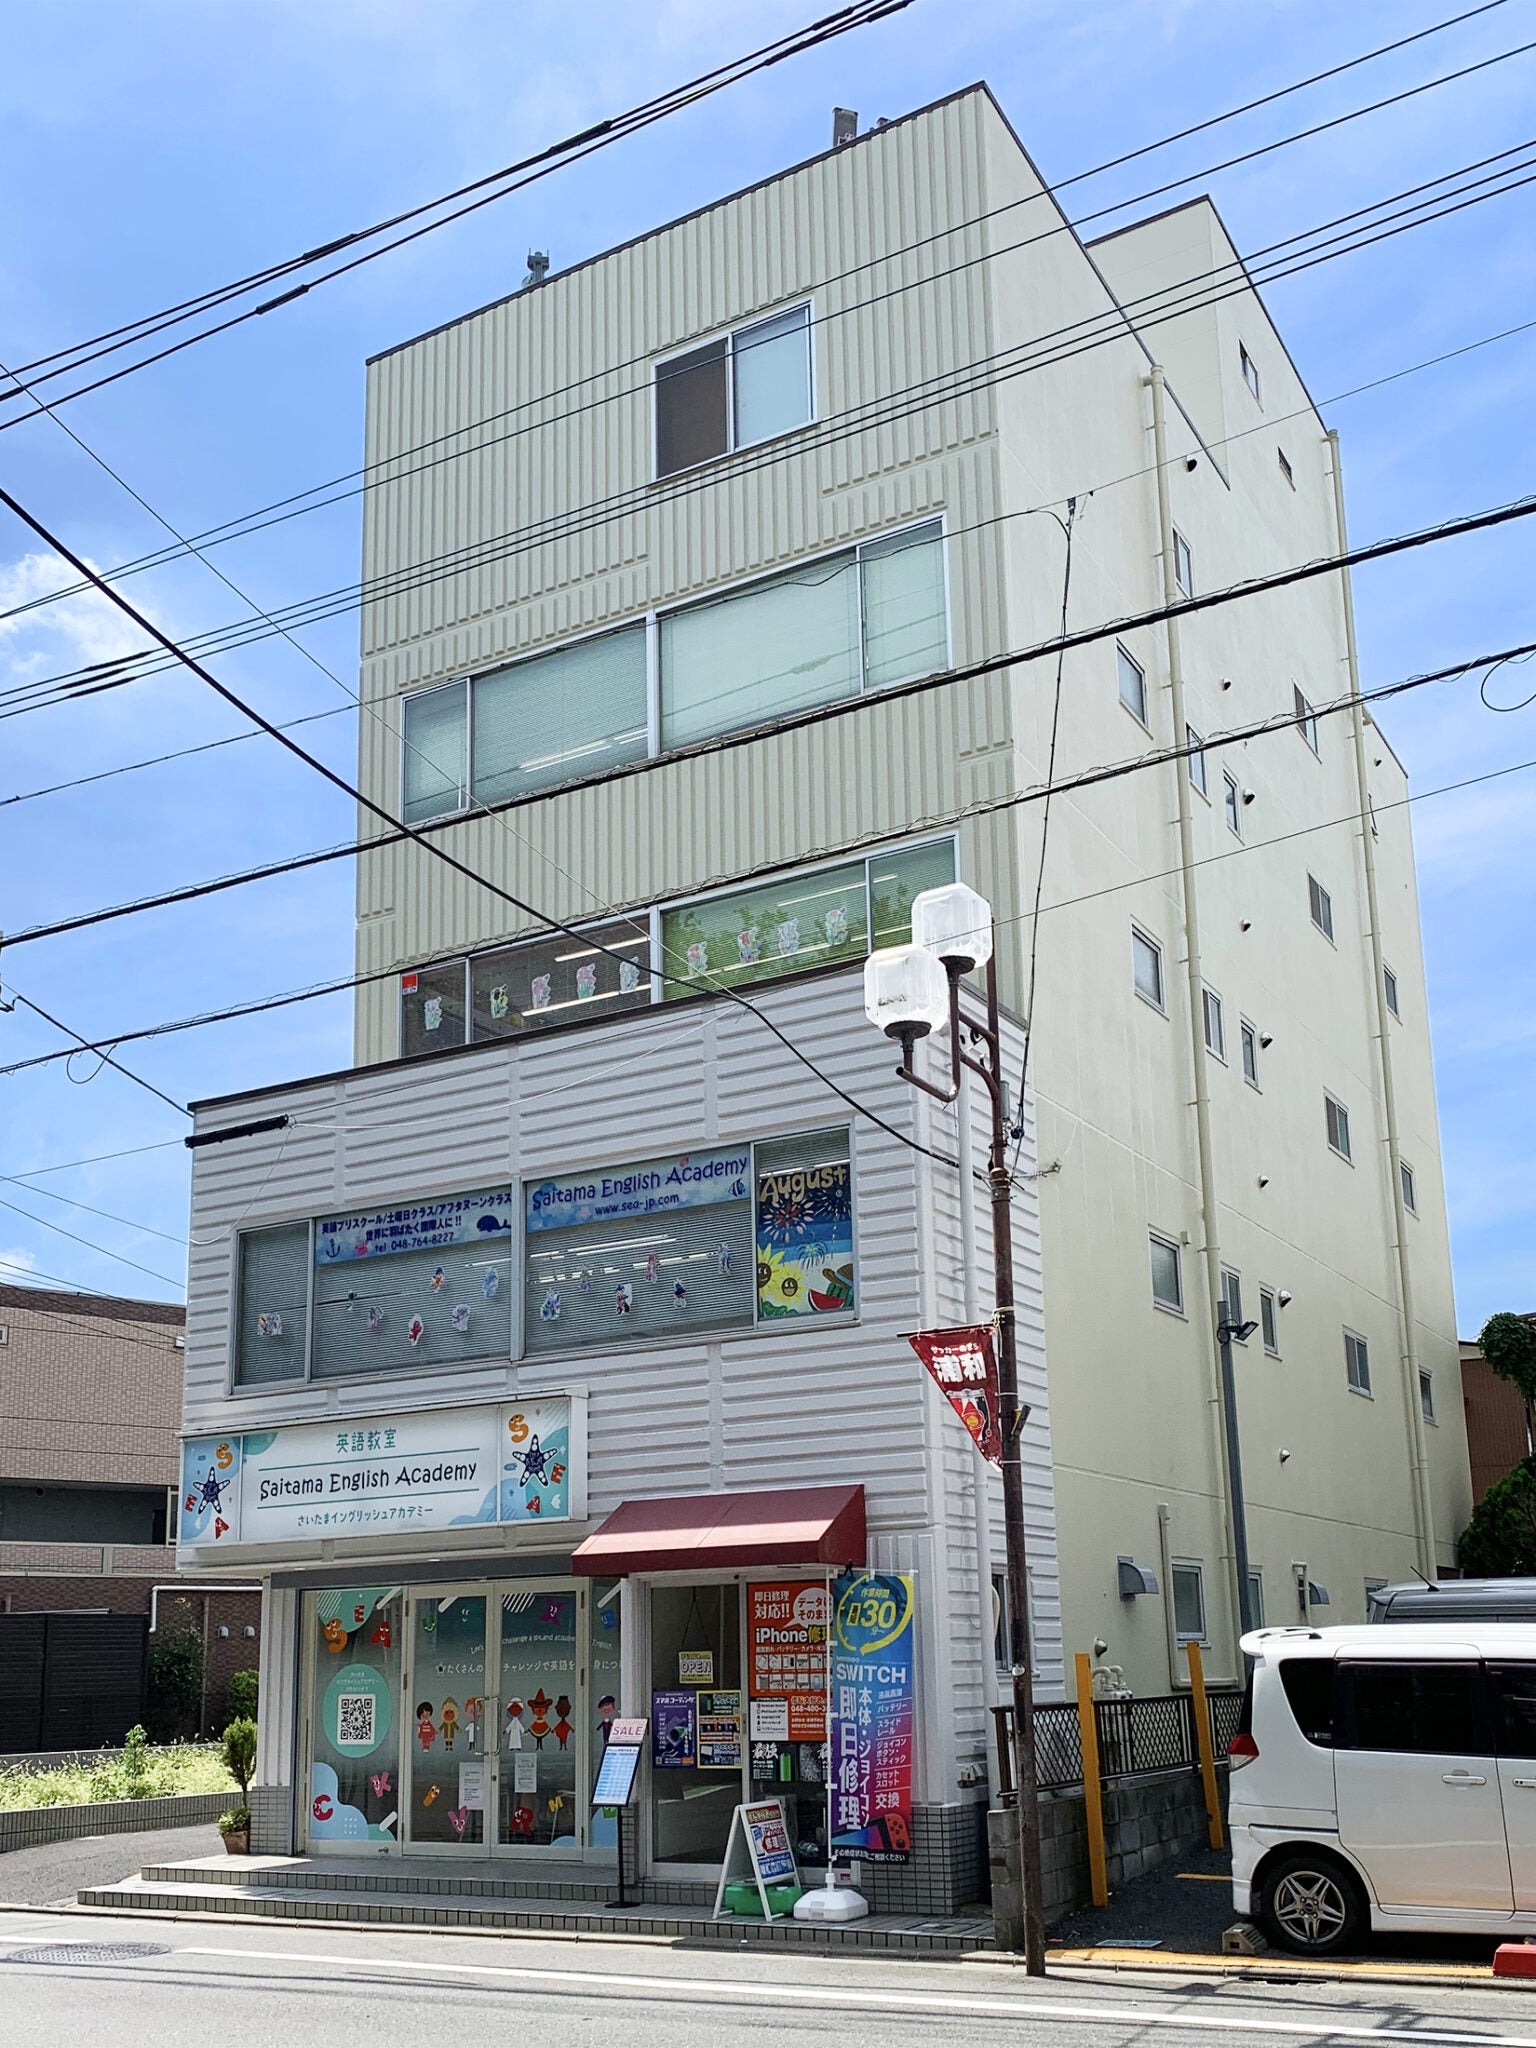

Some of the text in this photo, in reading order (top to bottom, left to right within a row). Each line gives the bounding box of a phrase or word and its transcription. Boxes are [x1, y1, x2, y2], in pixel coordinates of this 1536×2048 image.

[532, 1156, 748, 1211] Saitama English Academy
[759, 1165, 847, 1203] August
[594, 1193, 680, 1216] www.sea-jp.com
[374, 1232, 454, 1253] tel 048-764-8227
[931, 1351, 988, 1383] 浦和
[336, 1427, 397, 1454] 英語教室
[260, 1462, 477, 1501] Saitama English Academy
[297, 1505, 434, 1527] さいたまイングリッシュアカデミー
[754, 1590, 790, 1602] 即日修理
[754, 1602, 791, 1619] 対応!!
[860, 1598, 897, 1629] 30
[680, 1660, 712, 1674] OPEN
[836, 1662, 906, 1684] SWITCH
[877, 1702, 908, 1713] バッテリー
[612, 1726, 644, 1736] SALE
[877, 1717, 902, 1728] スライド
[877, 1727, 896, 1737] レール
[876, 1738, 907, 1750] ジョイコン
[838, 1685, 862, 1831] 即日修理
[858, 1685, 873, 1828] 本体・ジョイコン
[875, 1755, 907, 1767] スティック
[875, 1769, 900, 1780] カセット
[875, 1779, 900, 1788] スロット
[875, 1791, 900, 1811] 交換
